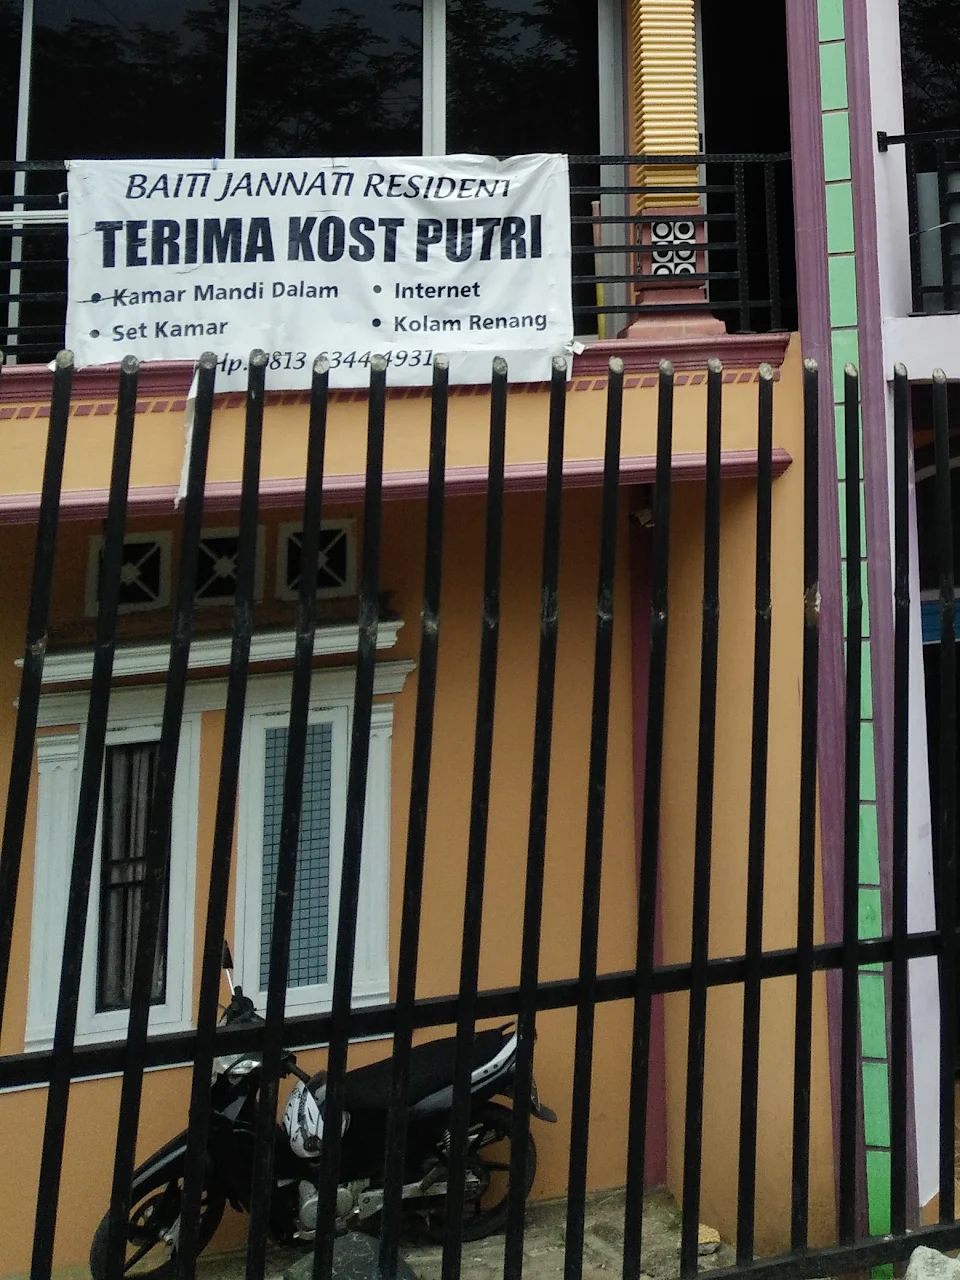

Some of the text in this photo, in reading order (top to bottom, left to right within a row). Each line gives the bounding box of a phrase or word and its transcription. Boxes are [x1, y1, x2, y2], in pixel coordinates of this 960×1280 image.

[125, 171, 512, 201] BAITI JANNATI RESIDENT
[95, 214, 542, 268] TERIMA KOST PUTRI
[112, 280, 339, 307] Kamar Mandi Dalam
[394, 281, 481, 299] Internet
[112, 321, 228, 341] Set Kamar
[394, 314, 547, 332] Kolam Renang
[313, 351, 372, 370] 344
